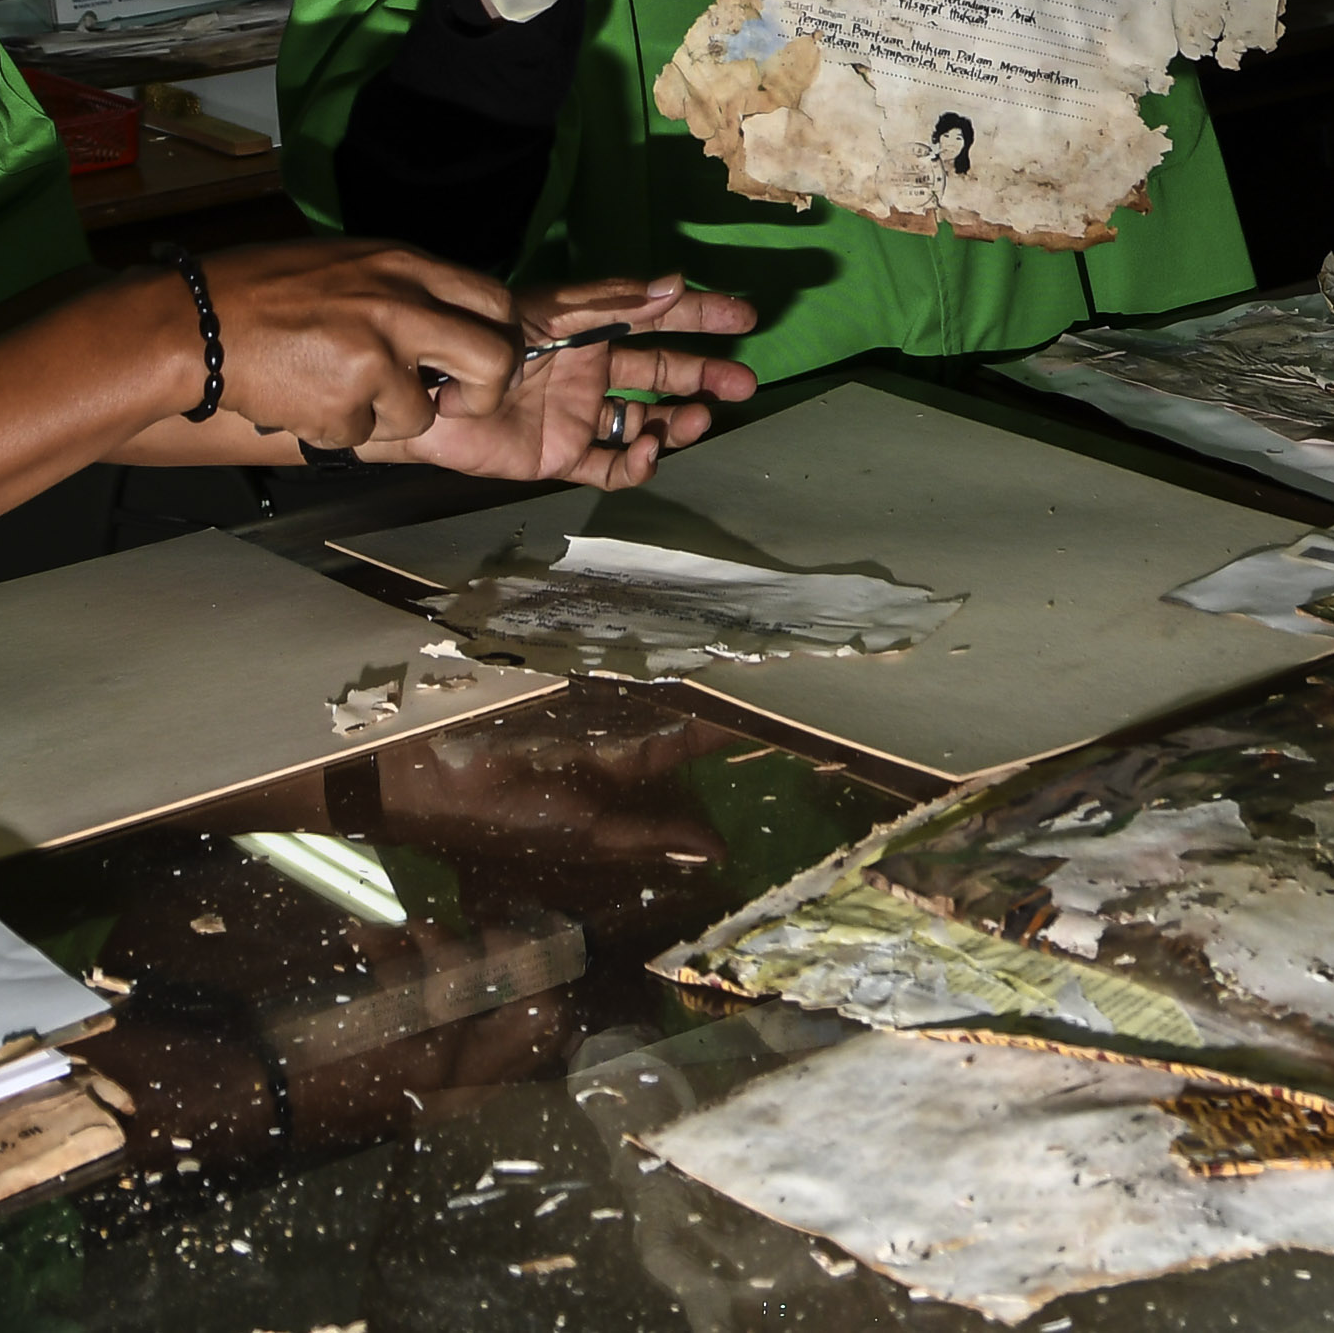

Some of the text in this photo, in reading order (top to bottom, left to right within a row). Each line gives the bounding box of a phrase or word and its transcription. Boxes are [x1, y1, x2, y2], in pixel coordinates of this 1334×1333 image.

[950, 8, 988, 25] Hukum
[1011, 8, 1037, 25] Anak
[798, 11, 1078, 89] Peranan Bantuan Hukum Dalam Meningkatkan
[869, 43, 937, 70] Memperoleh
[946, 62, 998, 86] Keadilan
